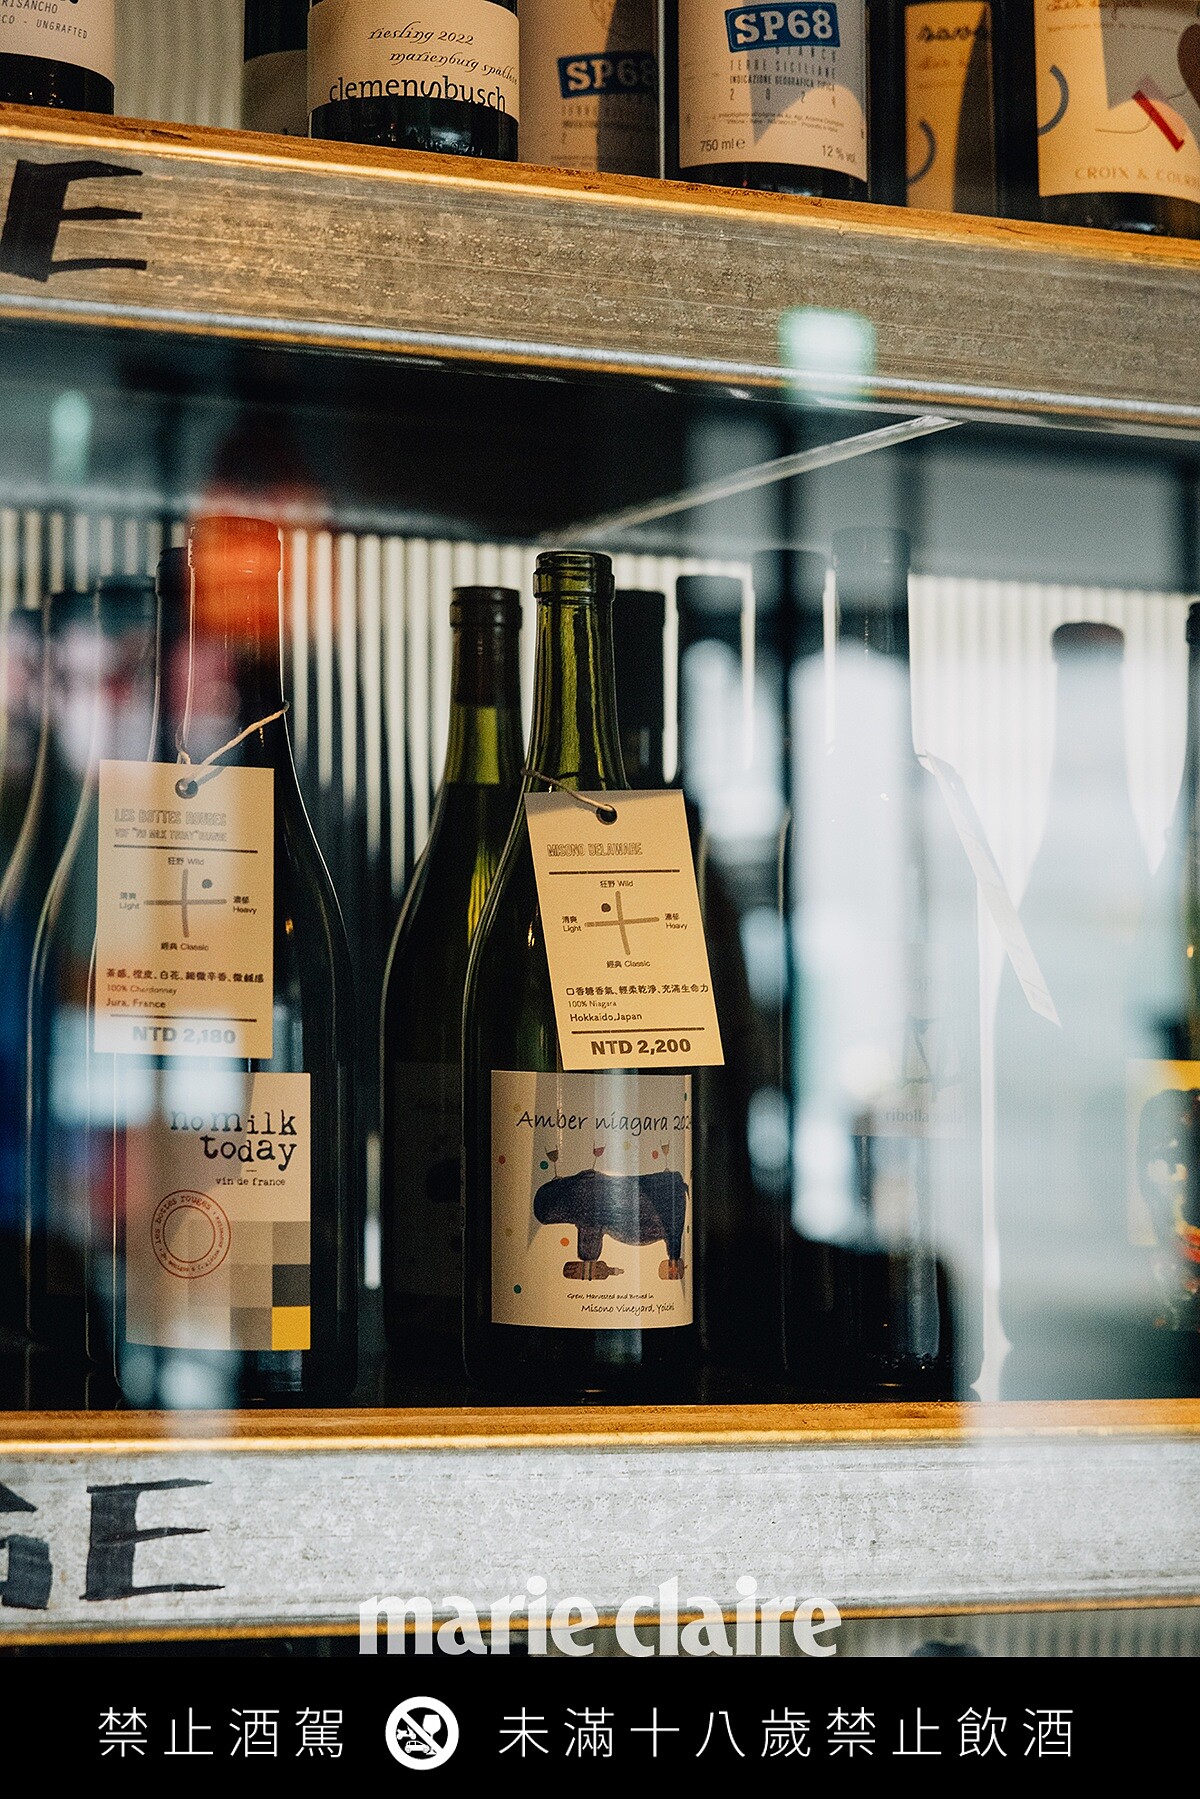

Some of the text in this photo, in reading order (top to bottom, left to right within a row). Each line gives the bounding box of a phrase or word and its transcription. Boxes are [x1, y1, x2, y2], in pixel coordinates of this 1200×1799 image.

[0, 14, 16, 25] CO
[36, 18, 88, 39] UNGRAFTED
[368, 20, 475, 46] riesling 2022
[732, 8, 835, 45] SP68
[389, 51, 480, 73] marienburg
[566, 57, 657, 92] SP68
[700, 139, 719, 152] 750
[722, 138, 735, 150] ml
[822, 144, 834, 157] 12
[1074, 165, 1131, 181] CROIX
[113, 808, 135, 824] LES
[138, 809, 182, 825] BOTTES
[546, 842, 644, 858] MISONO DELAWARE
[187, 857, 205, 866] Wild
[618, 880, 634, 888] Wild
[119, 901, 140, 911] Light
[232, 906, 258, 915] Heavy
[562, 925, 582, 934] Light
[665, 921, 688, 931] Heavy
[180, 941, 210, 951] Classic
[623, 959, 651, 969] Classic
[107, 983, 178, 996] 100% Chardonnay
[132, 998, 167, 1009] France
[567, 999, 617, 1010] 100% Niagara
[132, 1025, 178, 1043] NTD
[590, 1038, 692, 1056] NTD 2,200
[169, 1108, 298, 1136] no milk
[516, 1108, 588, 1130] Amber
[595, 1111, 668, 1137] niagara
[199, 1134, 298, 1172] today
[216, 1177, 286, 1187] vin de france
[616, 1292, 628, 1300] and
[648, 1292, 655, 1300] in
[581, 1303, 614, 1313] Misono
